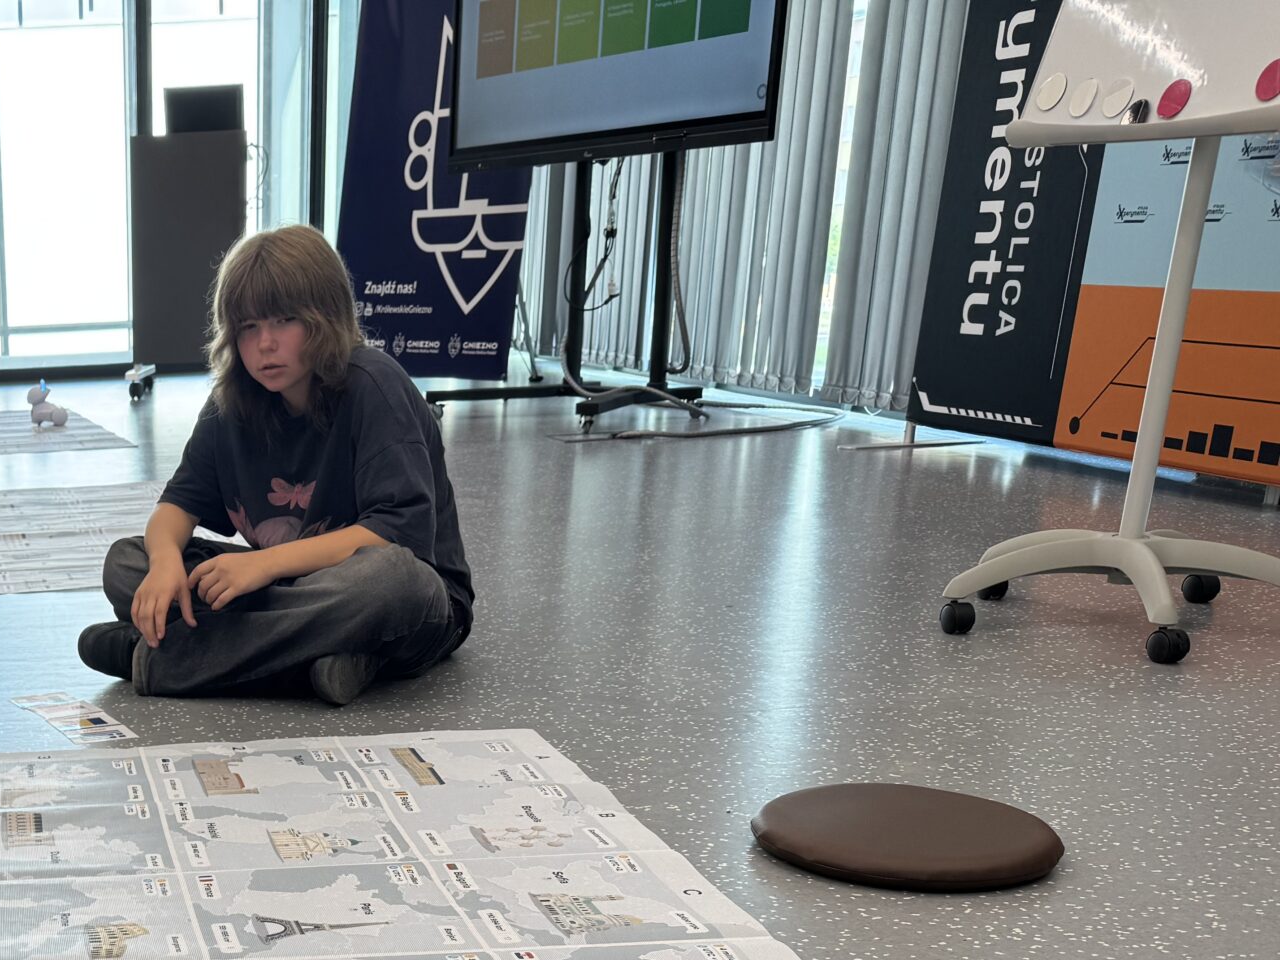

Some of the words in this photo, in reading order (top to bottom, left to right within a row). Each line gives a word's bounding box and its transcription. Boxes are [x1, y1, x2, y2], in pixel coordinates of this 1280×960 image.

[959, 2, 1036, 336] ymentu
[995, 146, 1045, 337] STOLICA
[364, 280, 396, 297] Znajdź
[397, 281, 417, 294] nas!
[406, 340, 440, 348] GNIEZNO
[462, 341, 498, 350] GNIEZNO
[551, 870, 569, 884] Sofia
[203, 882, 214, 897] France
[360, 902, 373, 915] Paris
